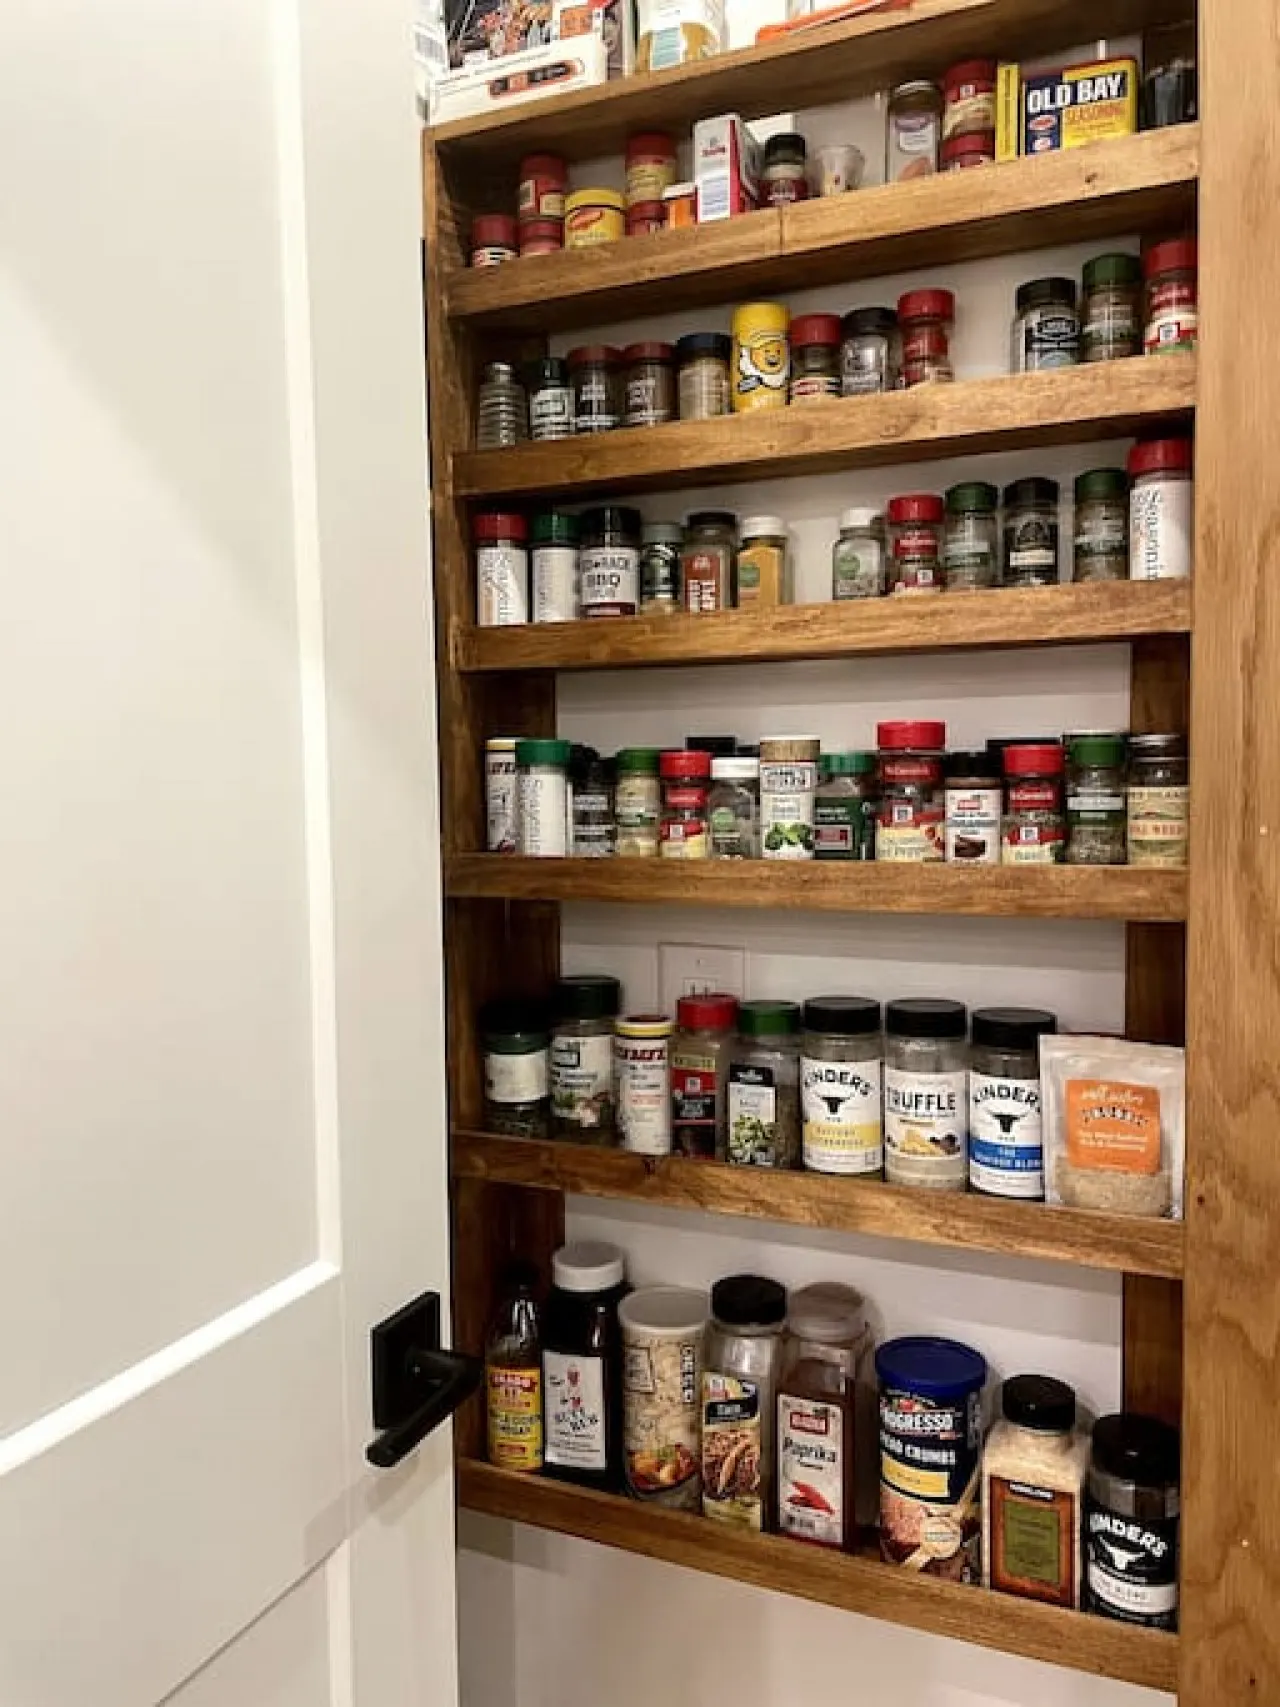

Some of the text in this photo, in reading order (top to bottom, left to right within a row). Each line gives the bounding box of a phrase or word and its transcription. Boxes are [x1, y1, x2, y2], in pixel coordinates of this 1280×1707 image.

[1028, 74, 1121, 114] OLD BAY
[782, 1436, 837, 1463] Paprika
